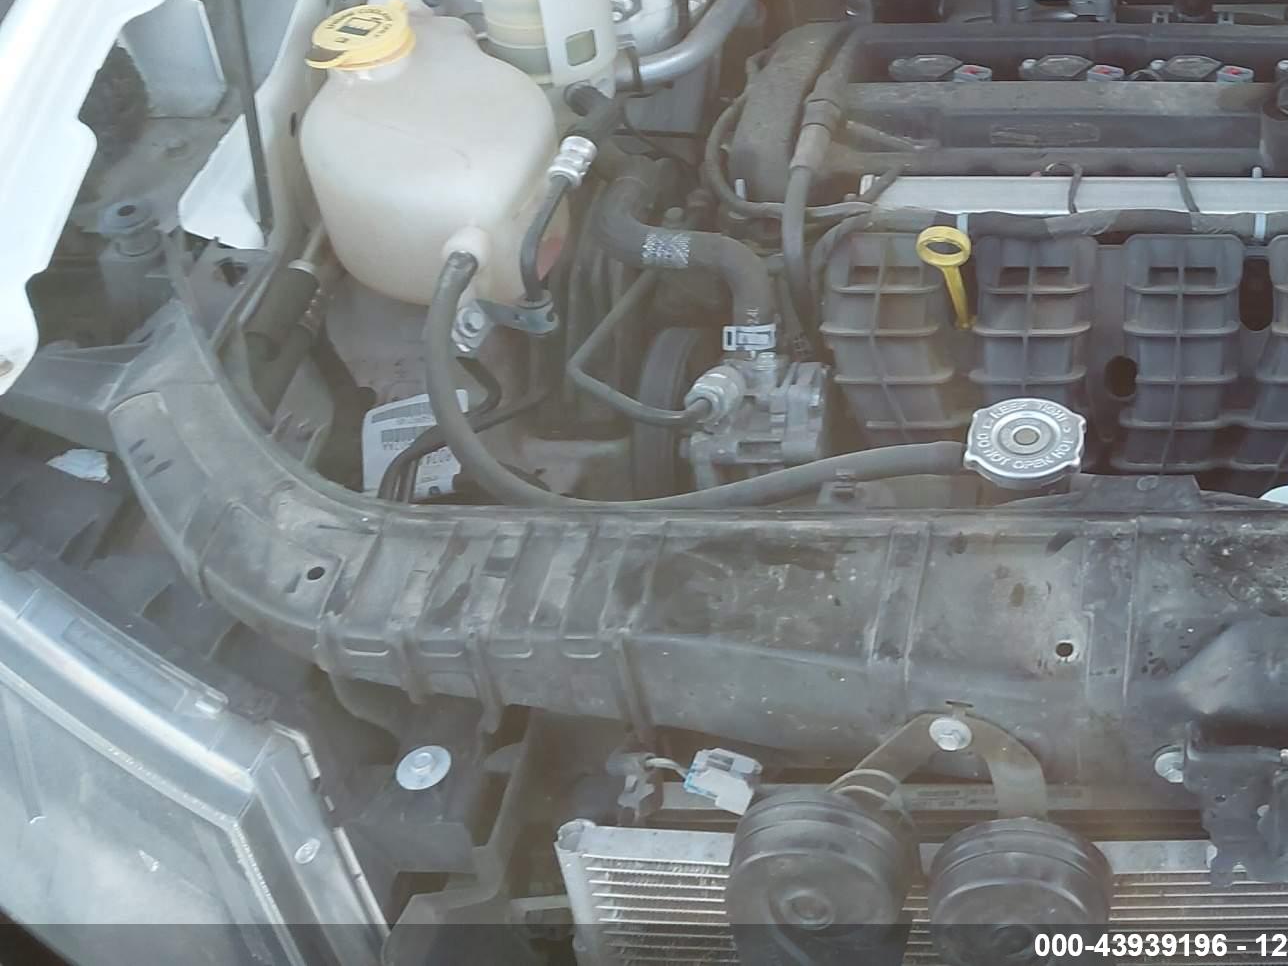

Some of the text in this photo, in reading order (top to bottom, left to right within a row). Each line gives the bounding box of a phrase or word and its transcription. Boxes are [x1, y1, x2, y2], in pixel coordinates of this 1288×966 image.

[981, 449, 1010, 466] NOT
[1012, 456, 1056, 470] OPEN
[1050, 440, 1075, 459] HOT
